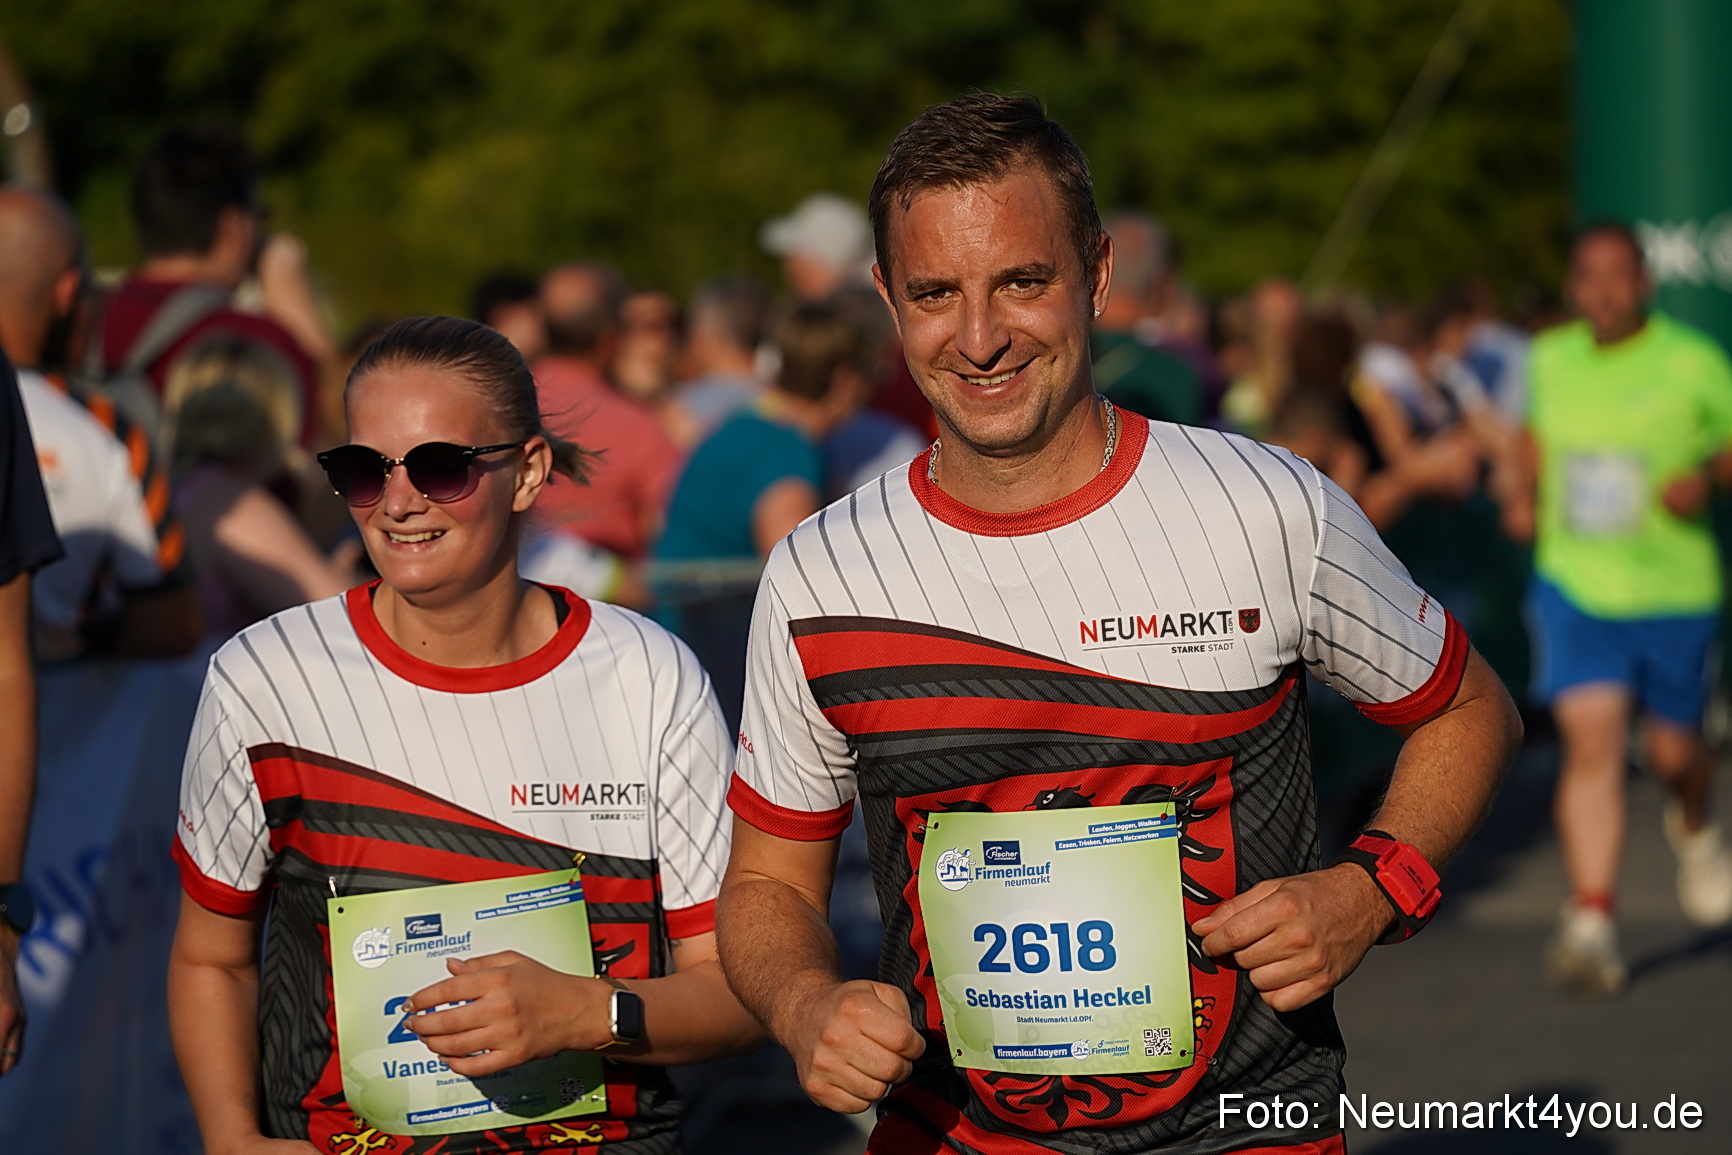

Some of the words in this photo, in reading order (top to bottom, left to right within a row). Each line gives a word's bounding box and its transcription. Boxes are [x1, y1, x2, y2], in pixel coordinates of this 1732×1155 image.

[1079, 610, 1233, 644] NEUMARKT
[1171, 645, 1206, 654] STARKE
[1207, 643, 1234, 652] STADT
[511, 783, 646, 806] NEUMARKT
[590, 813, 620, 821] STARKE
[1091, 825, 1114, 833] Laufen,
[1114, 822, 1138, 832] Joggen,
[1138, 819, 1161, 828] Walken
[1058, 841, 1078, 849] Essen,
[1078, 838, 1102, 847] Trinken,
[1103, 836, 1122, 844] Feiern,
[1123, 832, 1159, 842] Netzwerken
[975, 861, 1051, 880] Firmenlauf
[1004, 875, 1051, 887] neumarkt
[395, 931, 471, 955] Firmenlauf
[426, 944, 471, 959] neumarkt
[973, 920, 1117, 974] 2618
[965, 988, 1067, 1009] Sebastian
[1073, 985, 1152, 1008] Heckel
[1016, 1016, 1034, 1024] Stadt
[1035, 1016, 1068, 1024] Neumarkt
[996, 1047, 1068, 1059] firmenlauf.bayern
[1091, 1044, 1130, 1055] Firmenlauf
[383, 1060, 451, 1079] Vanes
[410, 1104, 489, 1124] firmenlauf.bayern
